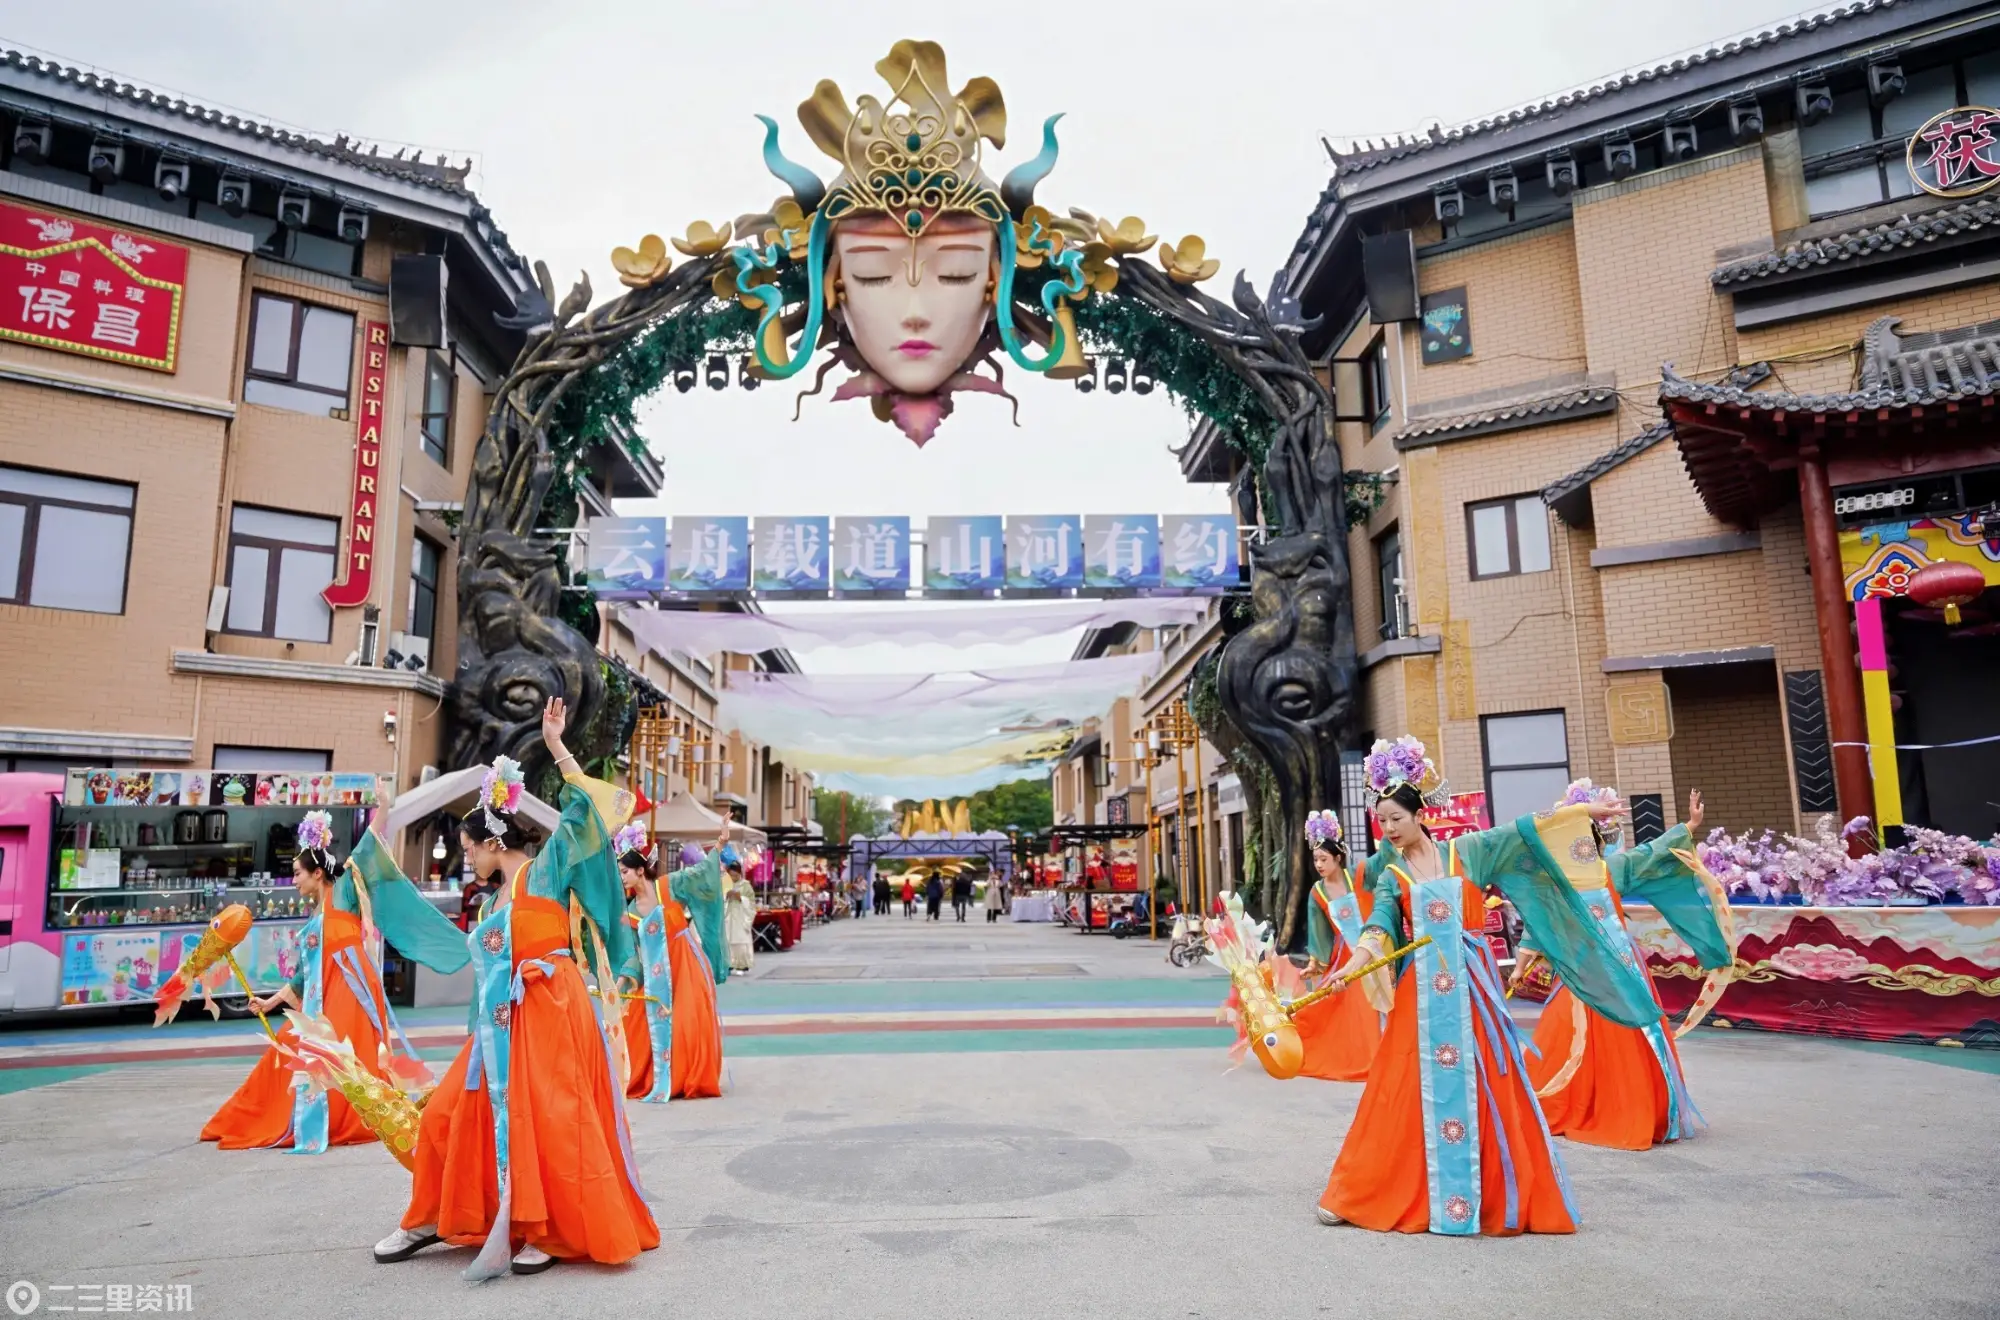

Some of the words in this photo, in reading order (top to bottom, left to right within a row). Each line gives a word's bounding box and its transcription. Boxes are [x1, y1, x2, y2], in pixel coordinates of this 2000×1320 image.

[25, 261, 146, 304] 中国料理
[18, 285, 141, 347] 保昌
[353, 326, 387, 571] RESTAURANT
[599, 520, 1230, 579] 云舟载道山河有约
